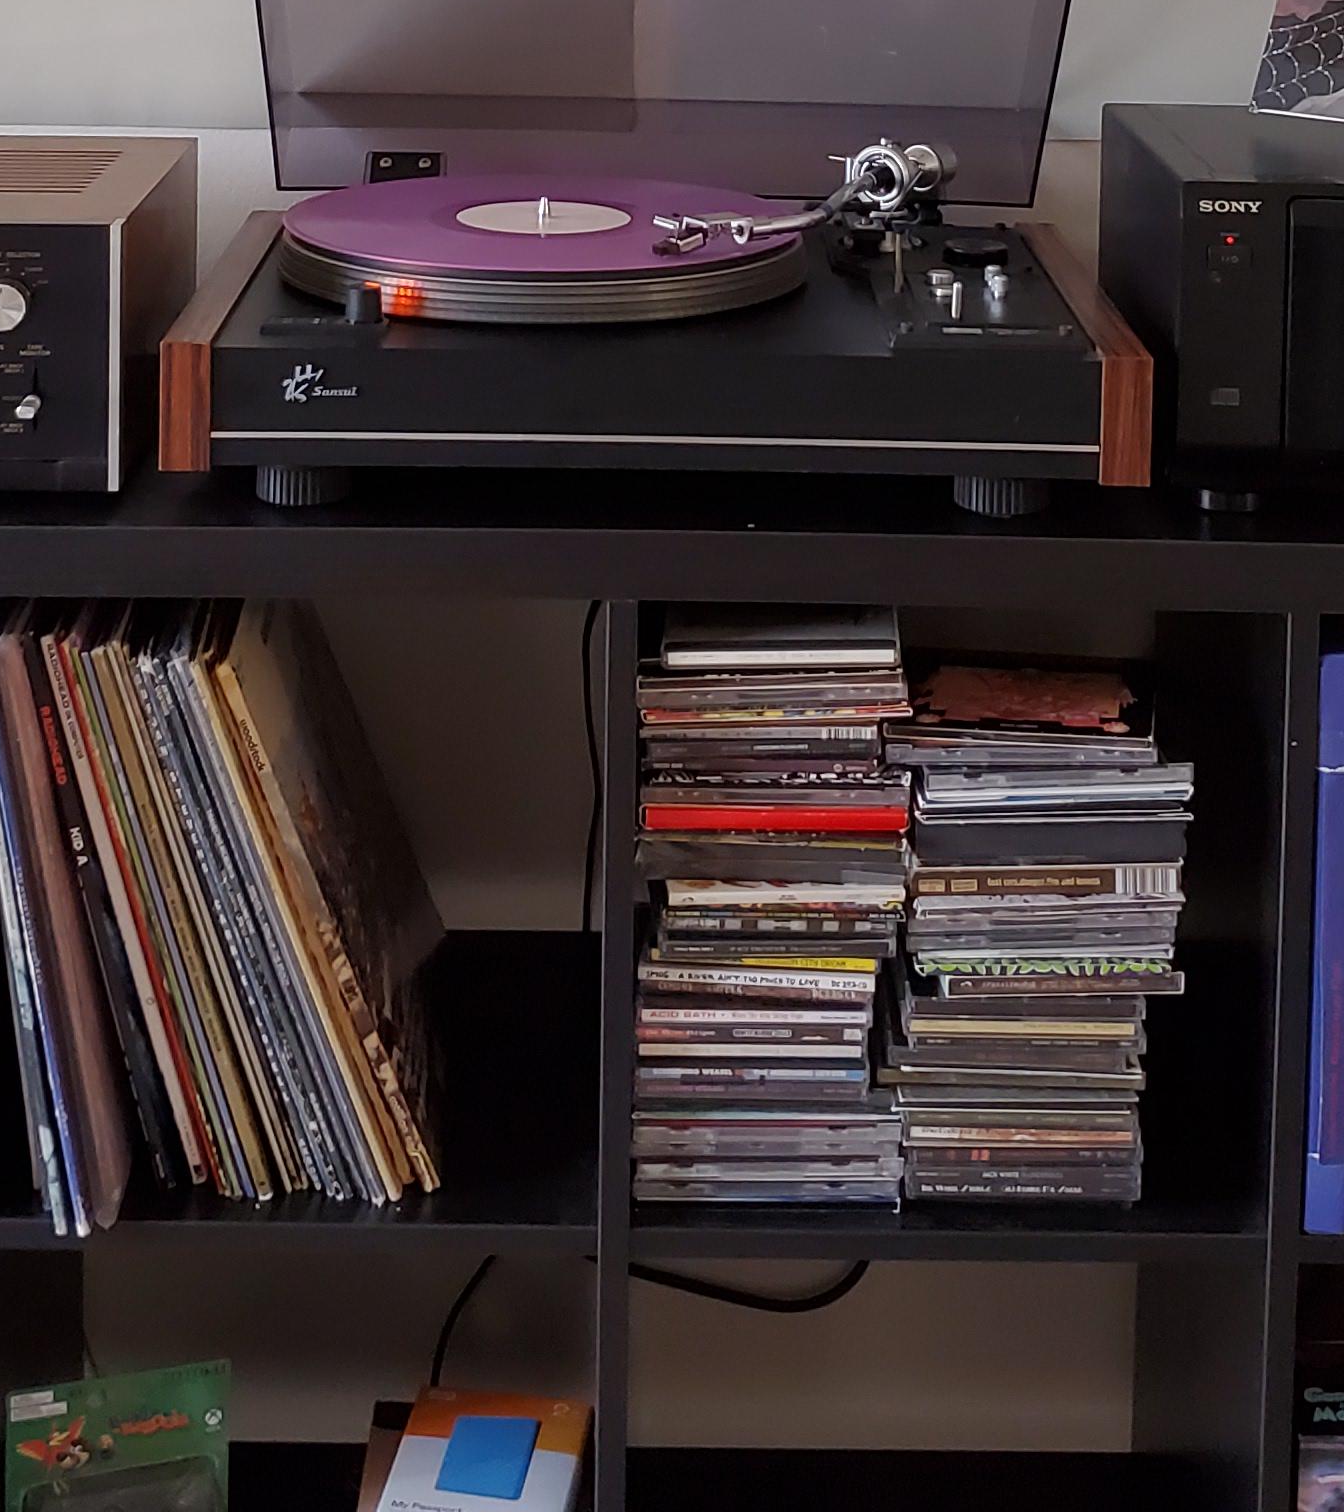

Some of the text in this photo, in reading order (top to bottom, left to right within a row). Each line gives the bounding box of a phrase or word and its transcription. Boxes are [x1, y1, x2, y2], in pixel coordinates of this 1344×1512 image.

[1198, 199, 1263, 213] SONY
[45, 643, 72, 711] RADIOHEAD
[38, 704, 89, 867] RADIOHEAD KID A
